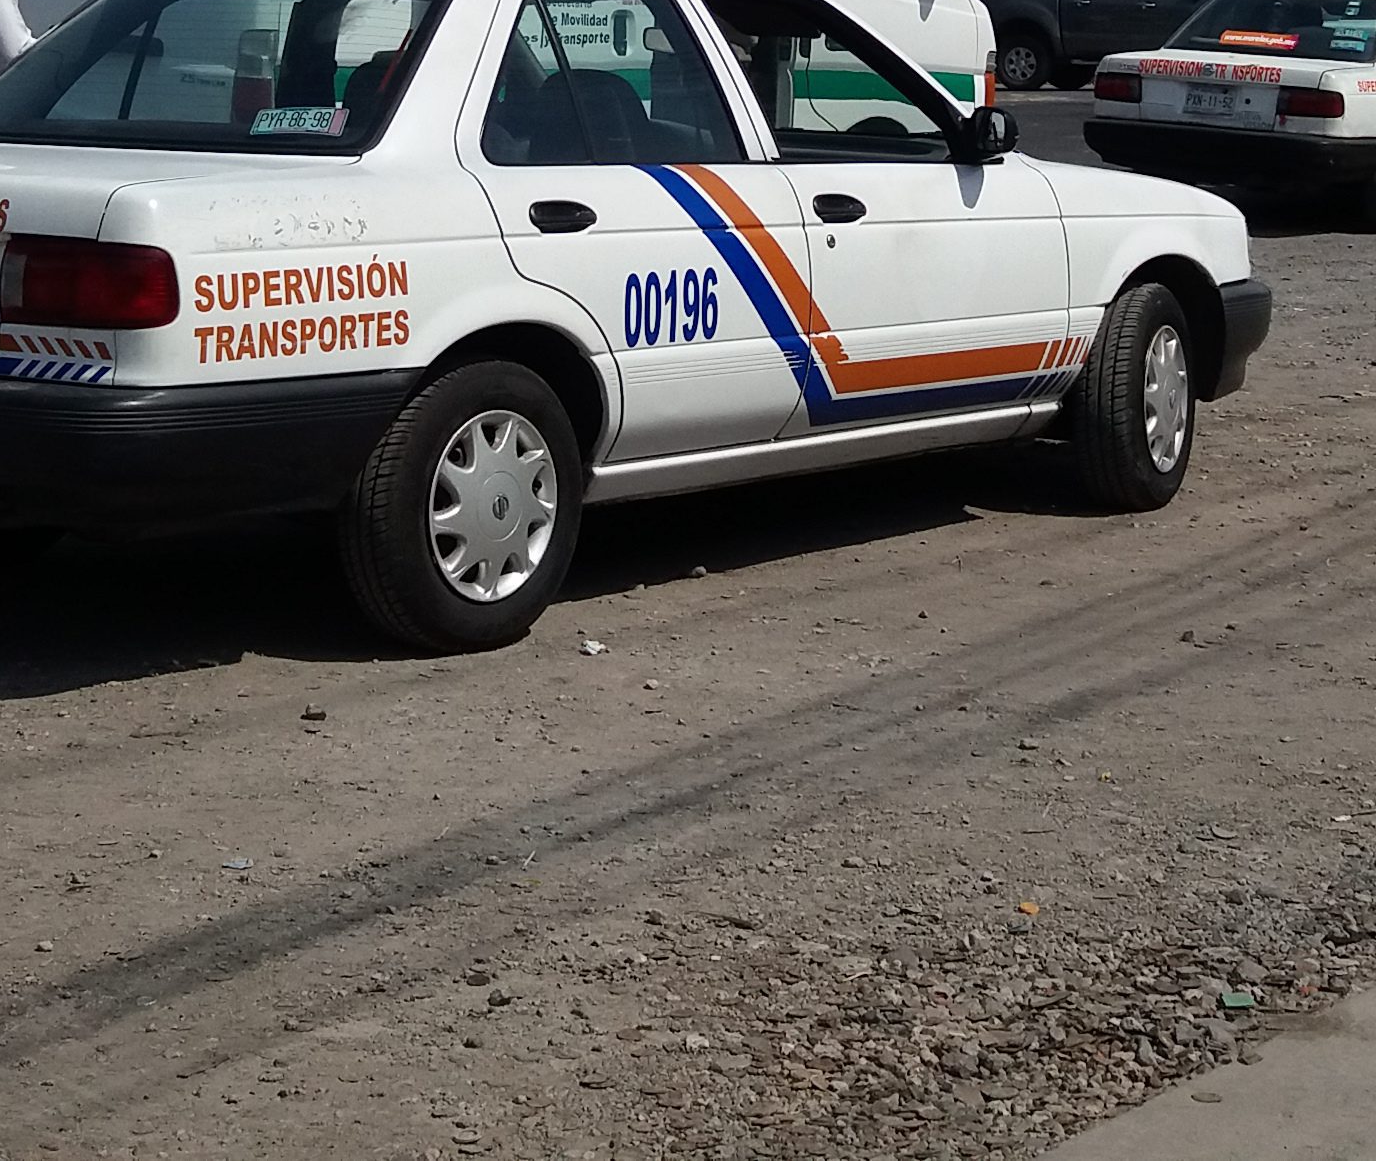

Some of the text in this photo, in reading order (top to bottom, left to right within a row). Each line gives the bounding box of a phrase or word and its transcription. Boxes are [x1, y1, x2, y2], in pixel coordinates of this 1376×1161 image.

[561, 13, 608, 27] Movilidad
[1137, 59, 1203, 77] SUPERVISION
[257, 109, 332, 130] PYR-86-98
[193, 254, 409, 313] SUPERVISIÓN
[623, 266, 719, 348] 00196
[194, 309, 410, 364] TRANSPORTES
